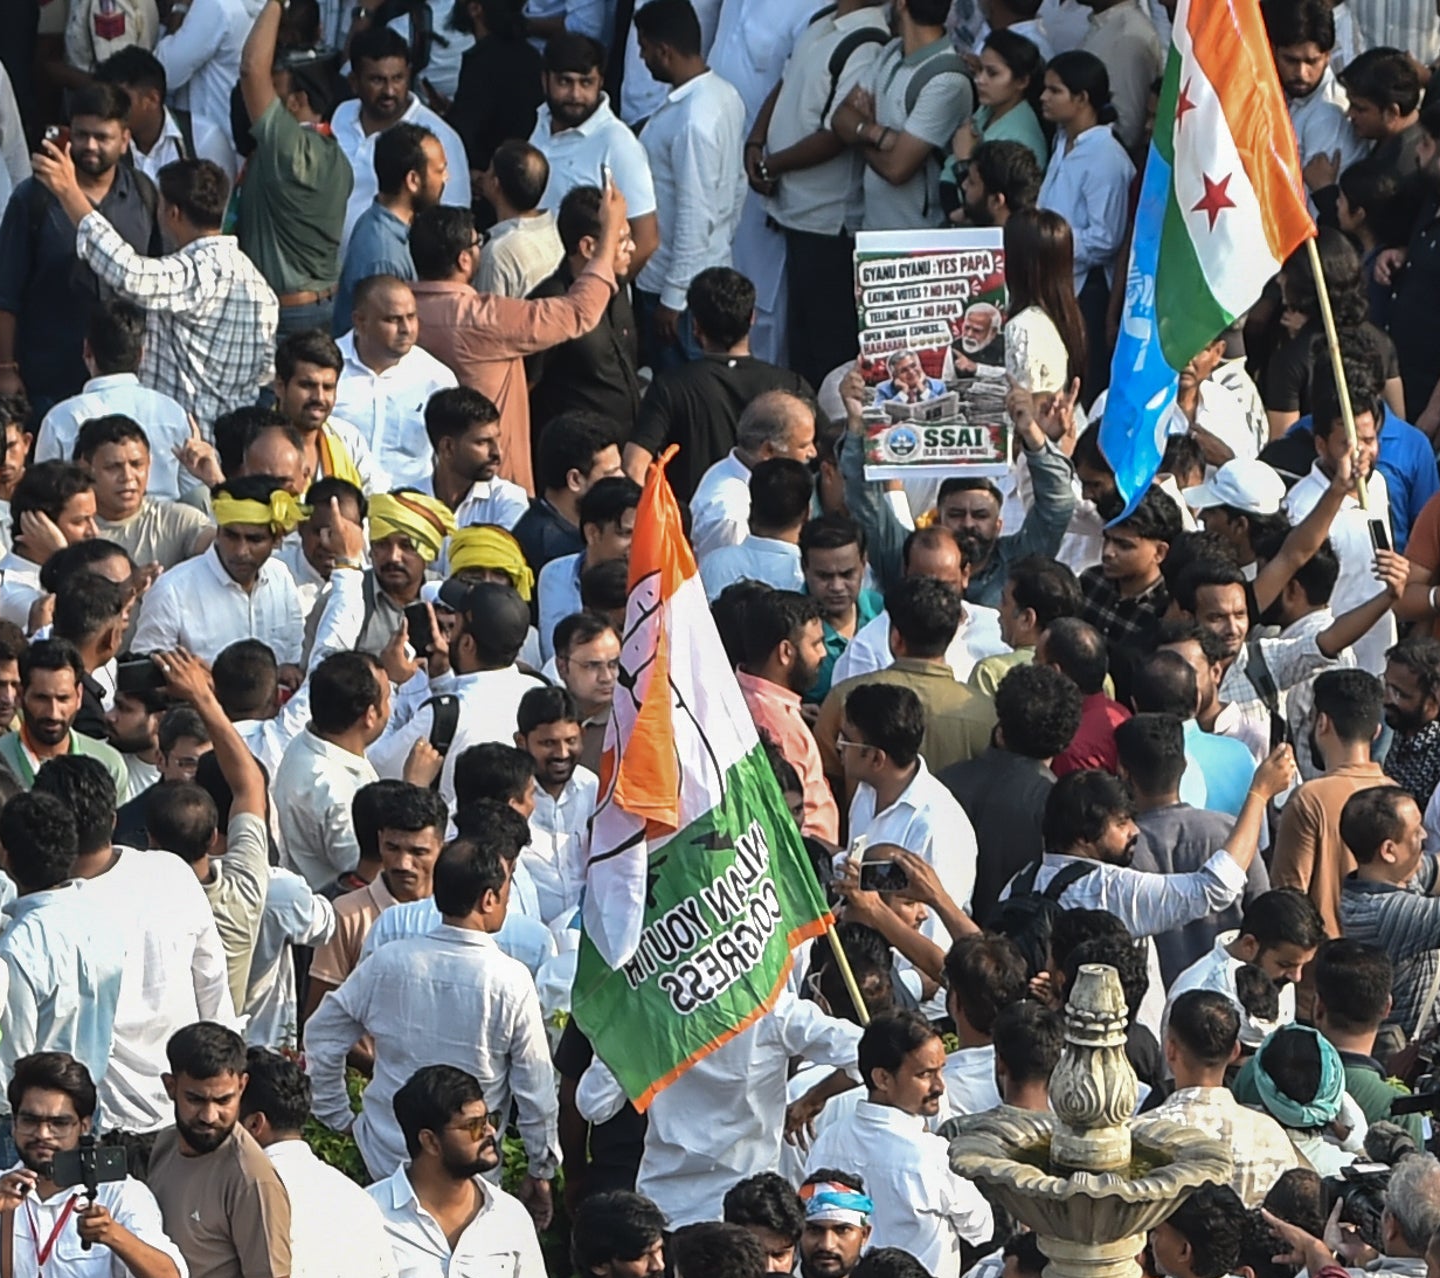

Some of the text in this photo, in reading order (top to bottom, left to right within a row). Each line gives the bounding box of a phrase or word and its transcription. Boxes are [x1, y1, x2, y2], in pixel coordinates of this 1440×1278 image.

[863, 264, 896, 282] GYANU
[899, 260, 930, 277] GYANU
[960, 254, 990, 272] PAPA
[897, 288, 921, 300] VOTES
[930, 285, 942, 296] NO
[944, 283, 965, 295] PAPA
[924, 306, 934, 318] NO
[936, 304, 958, 316] PAPA
[923, 428, 984, 448] SSAI
